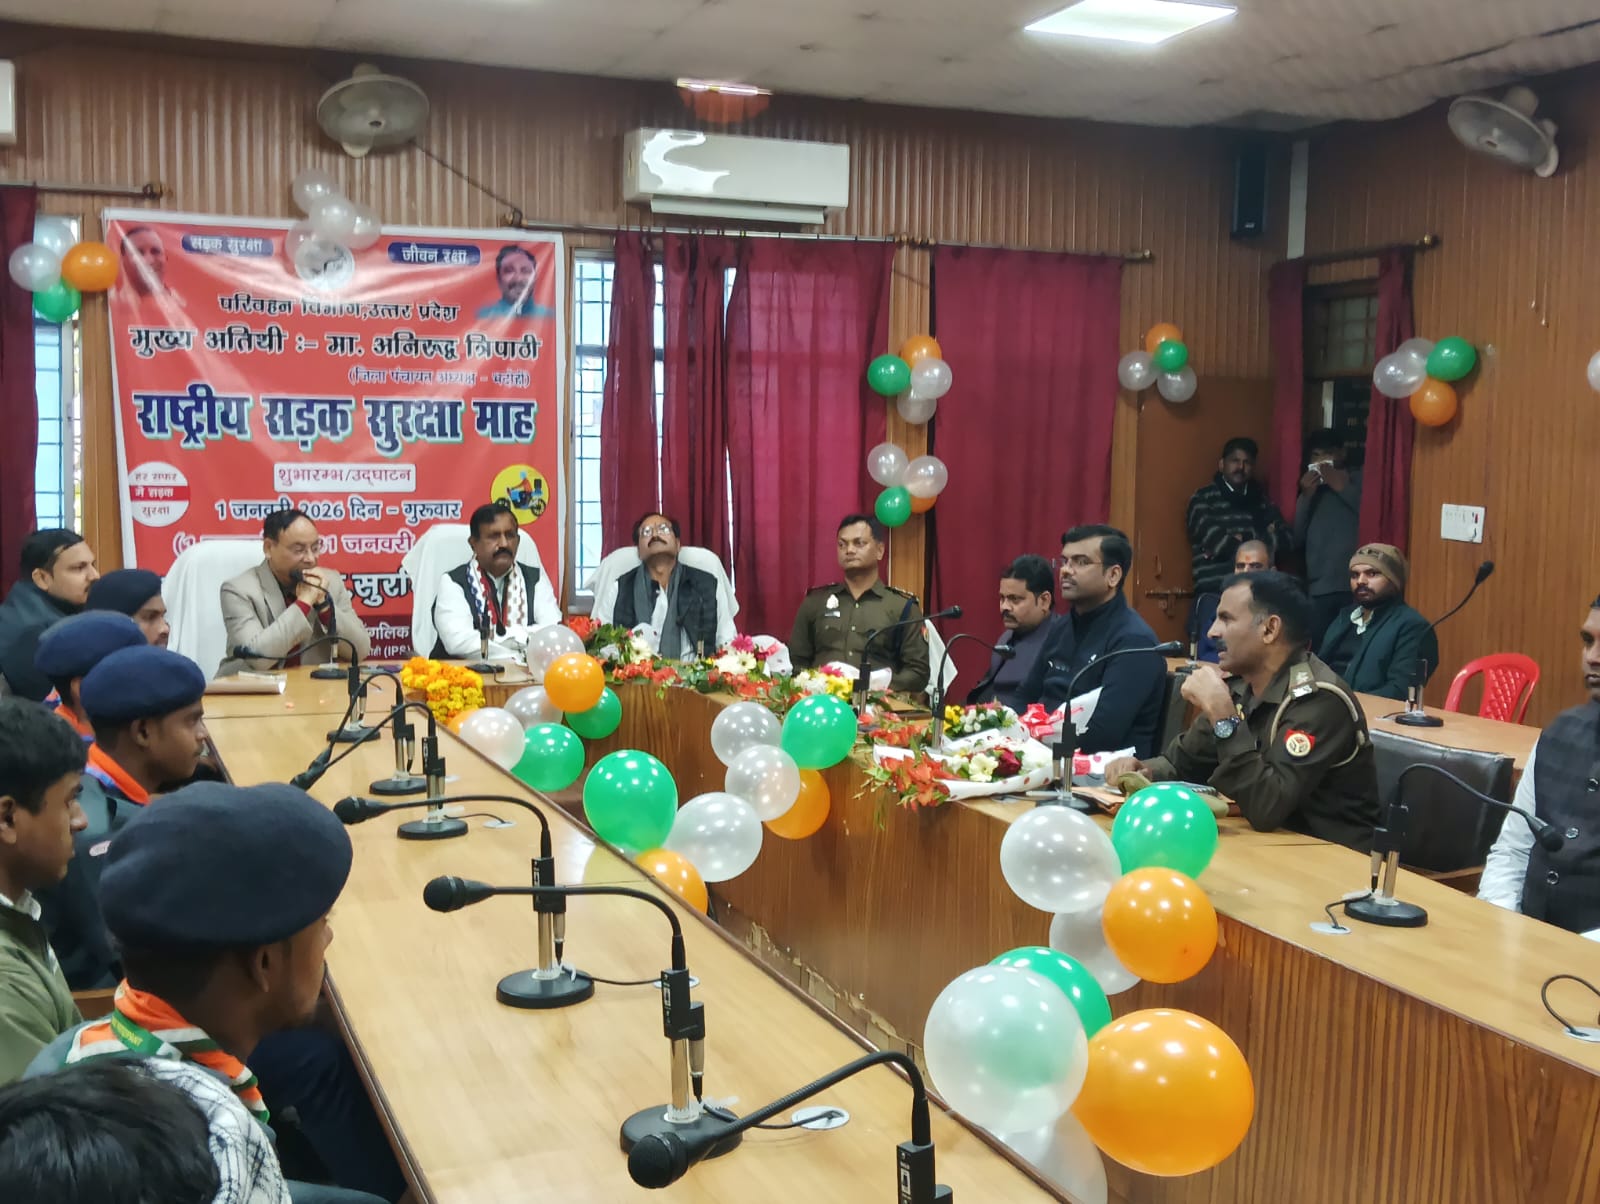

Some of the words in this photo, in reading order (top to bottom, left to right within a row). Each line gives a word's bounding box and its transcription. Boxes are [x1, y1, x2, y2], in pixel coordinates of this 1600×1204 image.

[402, 244, 438, 263] जीवन
[442, 248, 467, 265] रक्षा
[219, 293, 292, 314] परिवहन
[418, 302, 459, 321] प्रदेश
[130, 327, 195, 357] मुख्य
[326, 335, 364, 355] मा.
[466, 333, 542, 360] त्रिपाठी
[133, 383, 252, 447] राष्ट्रीय
[262, 398, 354, 452] सड़क
[363, 398, 463, 453] सुरक्षा
[472, 399, 537, 443] माह
[216, 502, 225, 518] 1
[350, 498, 381, 520] दिन
[343, 530, 413, 554] जनवरी
